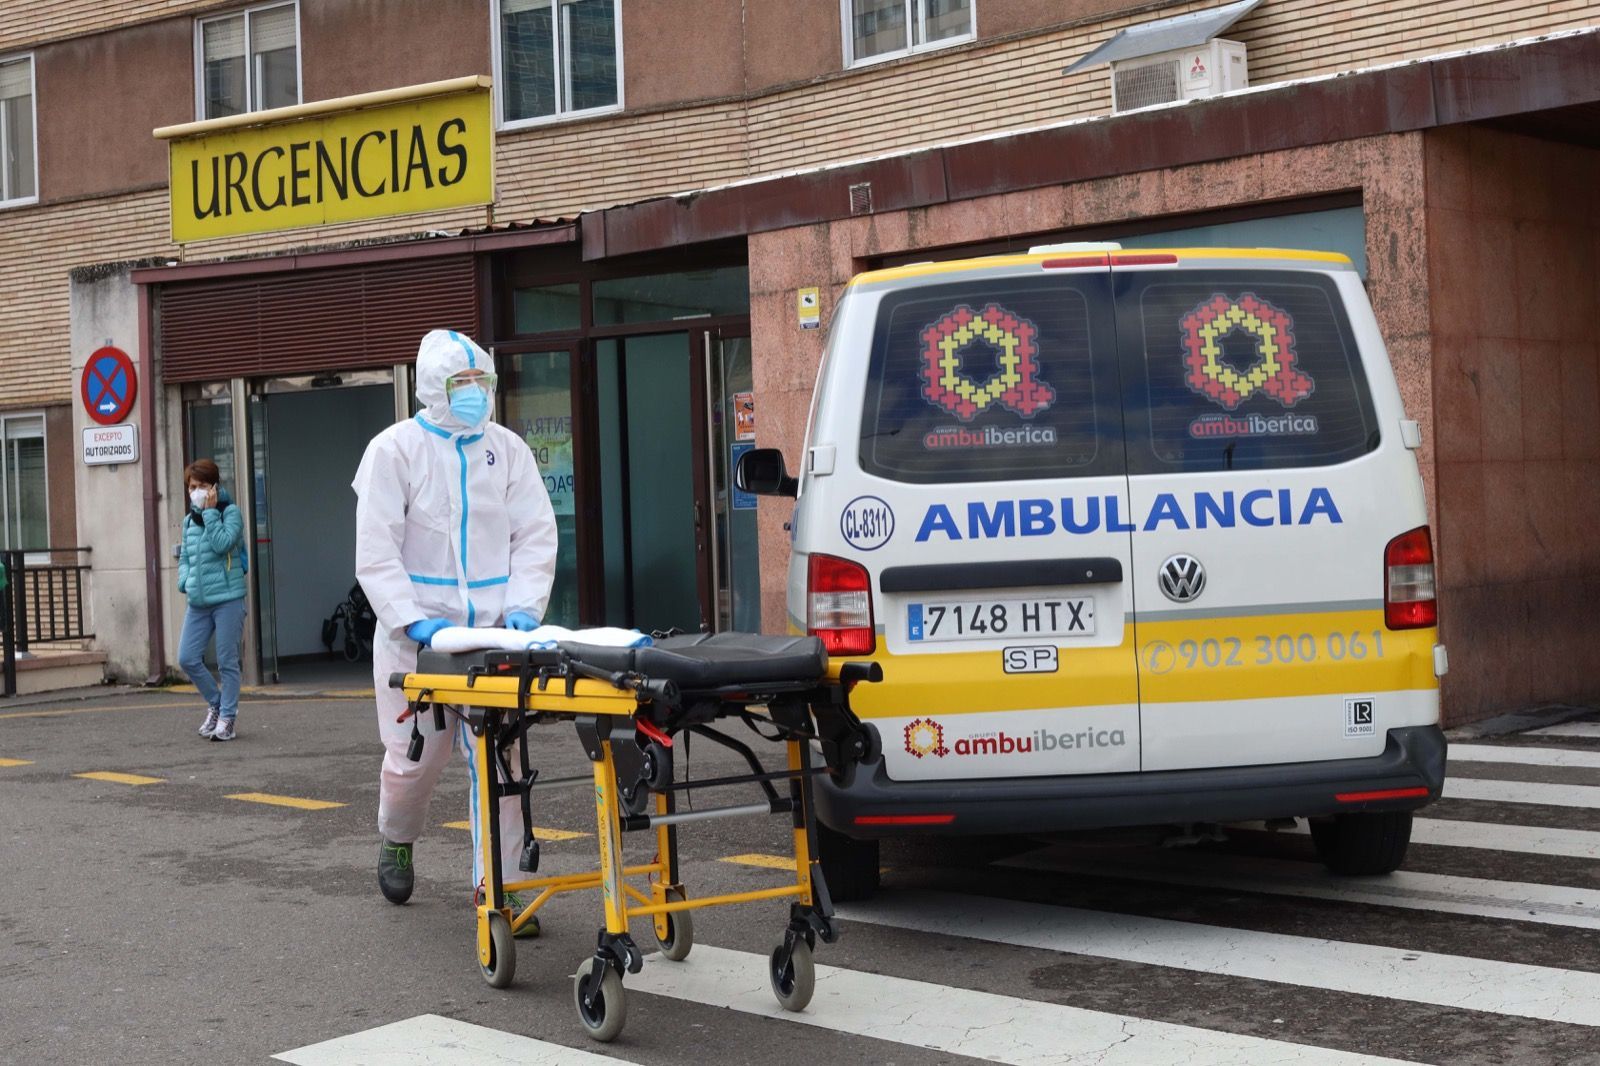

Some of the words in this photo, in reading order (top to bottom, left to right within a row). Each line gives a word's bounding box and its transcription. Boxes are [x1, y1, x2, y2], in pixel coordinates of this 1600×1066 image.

[191, 117, 469, 221] URGENCIAS
[1191, 415, 1316, 435] ambuiberica
[94, 431, 123, 442] EXCEPTO
[926, 427, 1054, 447] ambuiberica
[85, 444, 132, 457] AUTORIZADOS
[846, 507, 888, 539] CL-8311
[914, 487, 1344, 543] AMBULANCIA
[928, 603, 1008, 637] 7148
[1021, 601, 1086, 632] HTX
[911, 626, 920, 636] E
[1009, 649, 1052, 670] SP
[1178, 636, 1243, 669] 902
[1254, 633, 1317, 665] 300
[1326, 630, 1385, 661] 061
[1359, 725, 1372, 733] 9001
[954, 726, 1126, 756] ambuiberica
